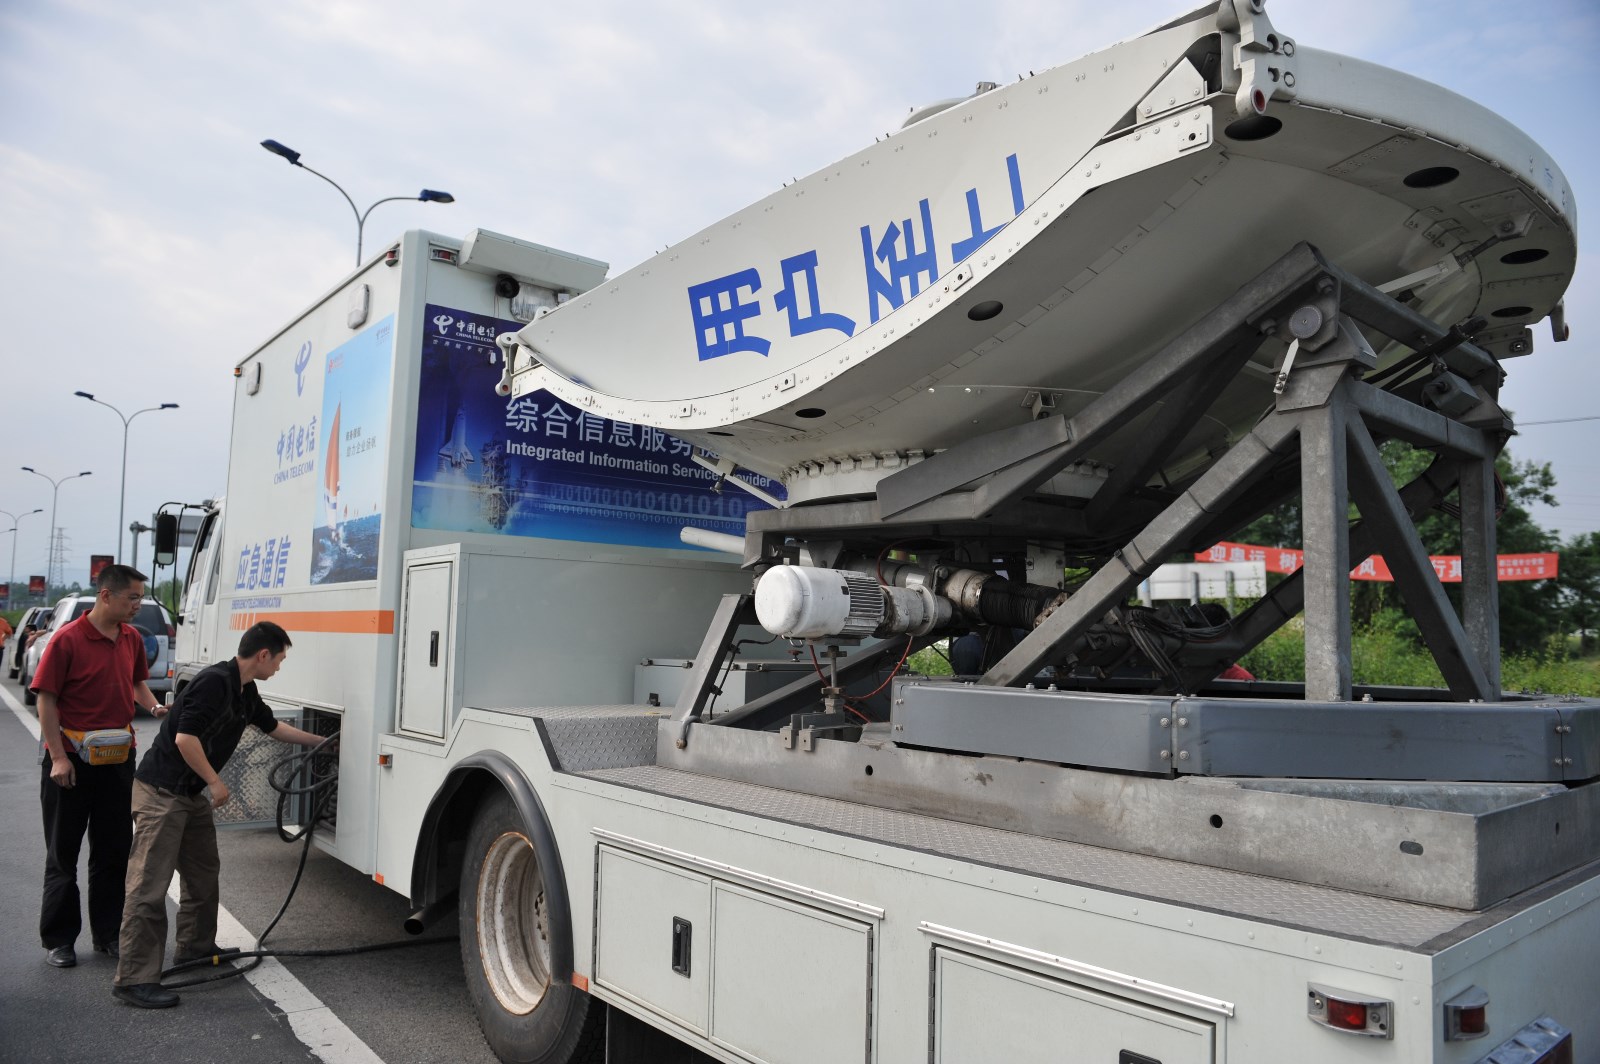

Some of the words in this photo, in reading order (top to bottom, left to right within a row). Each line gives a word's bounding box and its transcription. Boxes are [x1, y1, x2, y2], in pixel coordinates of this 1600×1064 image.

[456, 319, 495, 338] 中国电信
[456, 331, 472, 339] CHINA
[277, 415, 317, 470] 中国电信
[506, 439, 585, 463] Integrated
[589, 449, 669, 475] Information
[273, 468, 289, 485] CHINA
[290, 459, 314, 480] TELECOM
[234, 534, 292, 591] 应急通信
